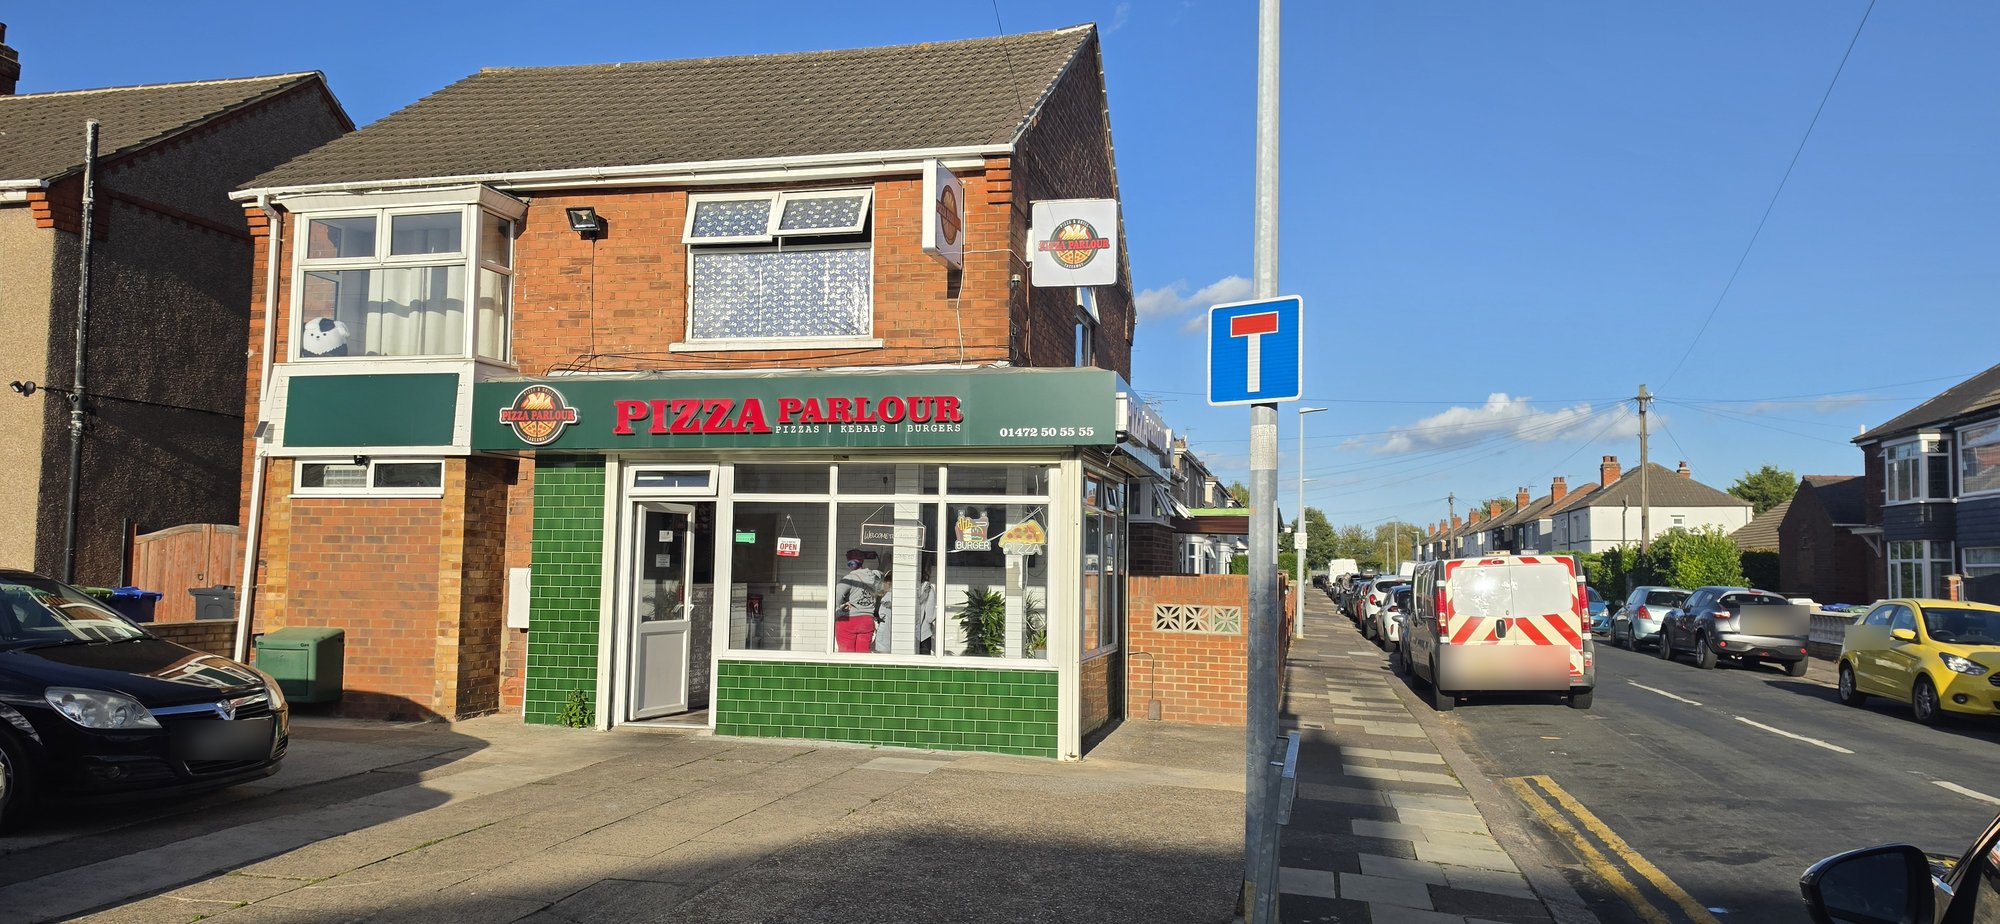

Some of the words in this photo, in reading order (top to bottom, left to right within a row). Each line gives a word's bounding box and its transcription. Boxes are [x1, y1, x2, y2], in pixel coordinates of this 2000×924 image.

[1039, 241, 1066, 250] PIZZA
[1068, 239, 1109, 249] PARLOUR
[502, 410, 529, 420] PIZZA
[531, 410, 575, 420] PARLOUR
[613, 399, 772, 434] PIZZA
[777, 396, 963, 424] PARLOUR
[775, 425, 820, 434] PIZZAS
[840, 424, 886, 433] KEBABS
[907, 424, 961, 433] BURGERS
[999, 427, 1038, 437] 01472
[1040, 427, 1057, 437] 50
[1059, 427, 1075, 437] 55
[1078, 427, 1094, 436] 55
[780, 543, 798, 551] OPEN
[956, 541, 990, 550] BURGER
[1004, 542, 1041, 554] PIZZA
